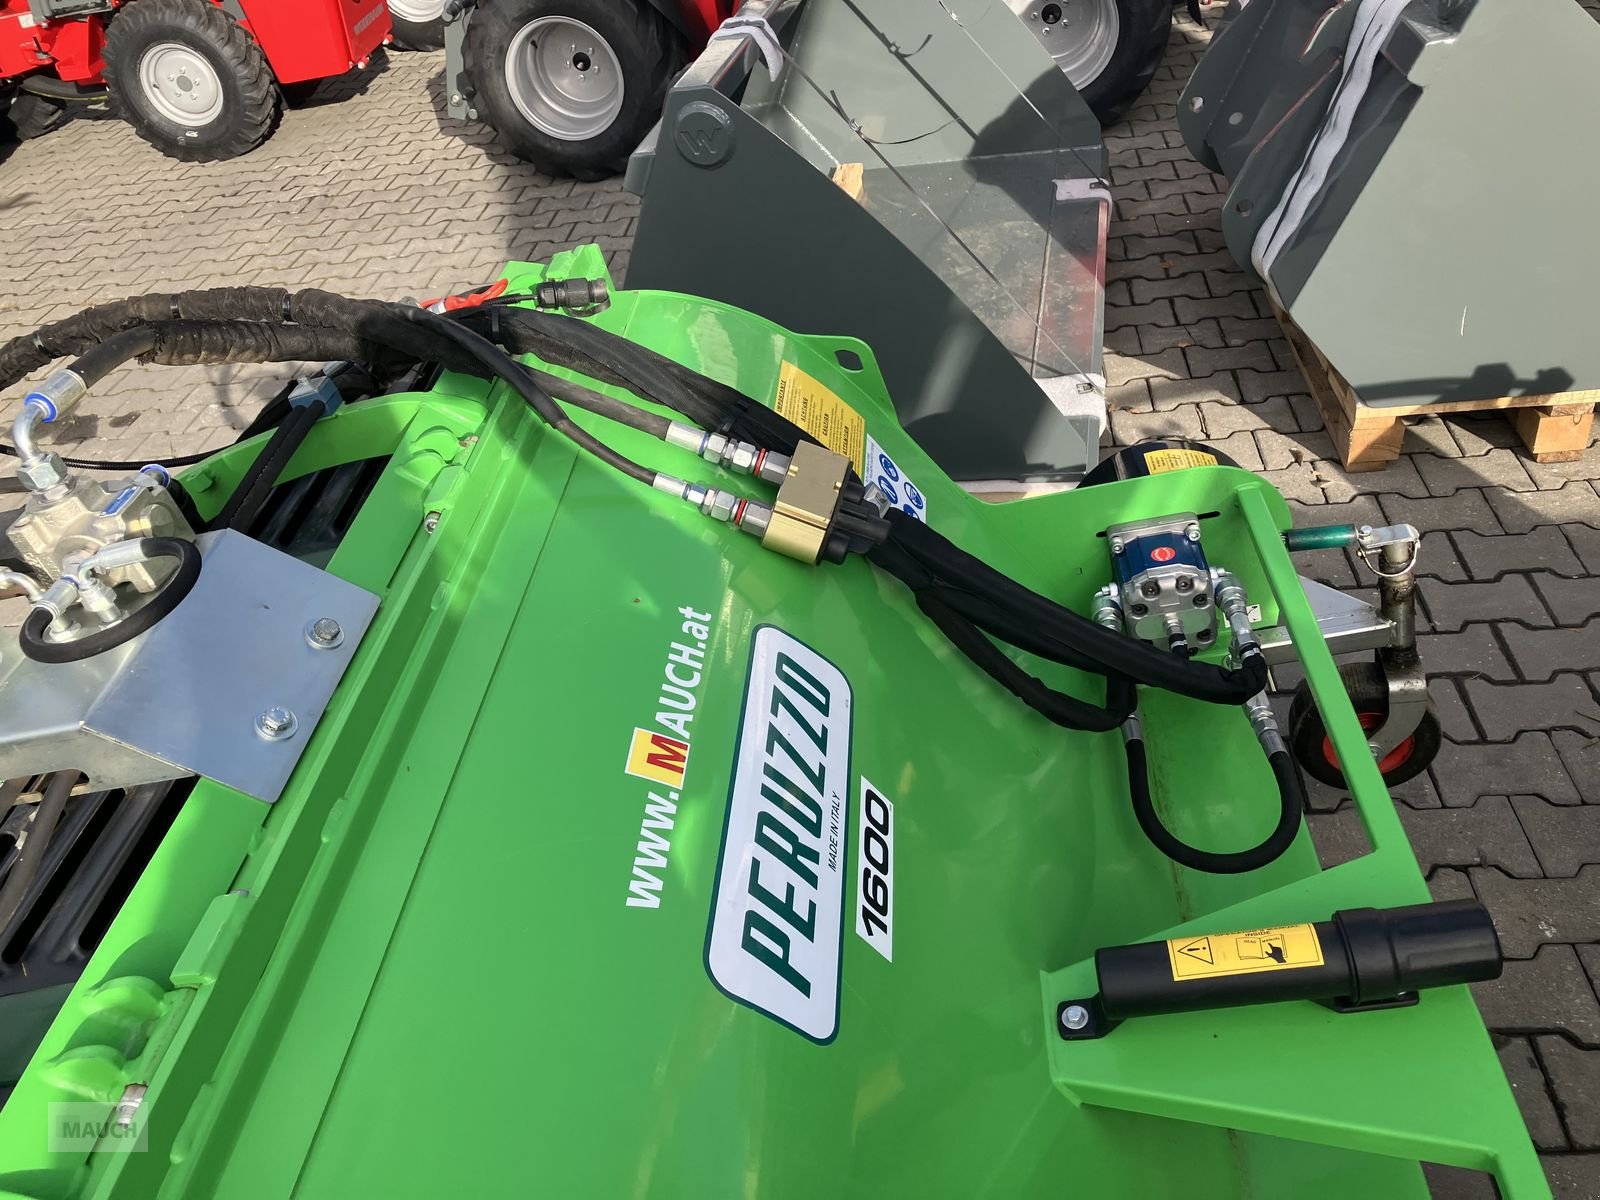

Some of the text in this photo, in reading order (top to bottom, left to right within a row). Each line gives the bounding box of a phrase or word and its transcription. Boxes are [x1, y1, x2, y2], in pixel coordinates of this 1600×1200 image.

[821, 412, 829, 437] CAUTION
[741, 651, 832, 999] PERUZZO
[828, 790, 841, 873] MADE IN ITALY
[862, 788, 889, 937] 1600
[1244, 930, 1271, 938] INSIDE
